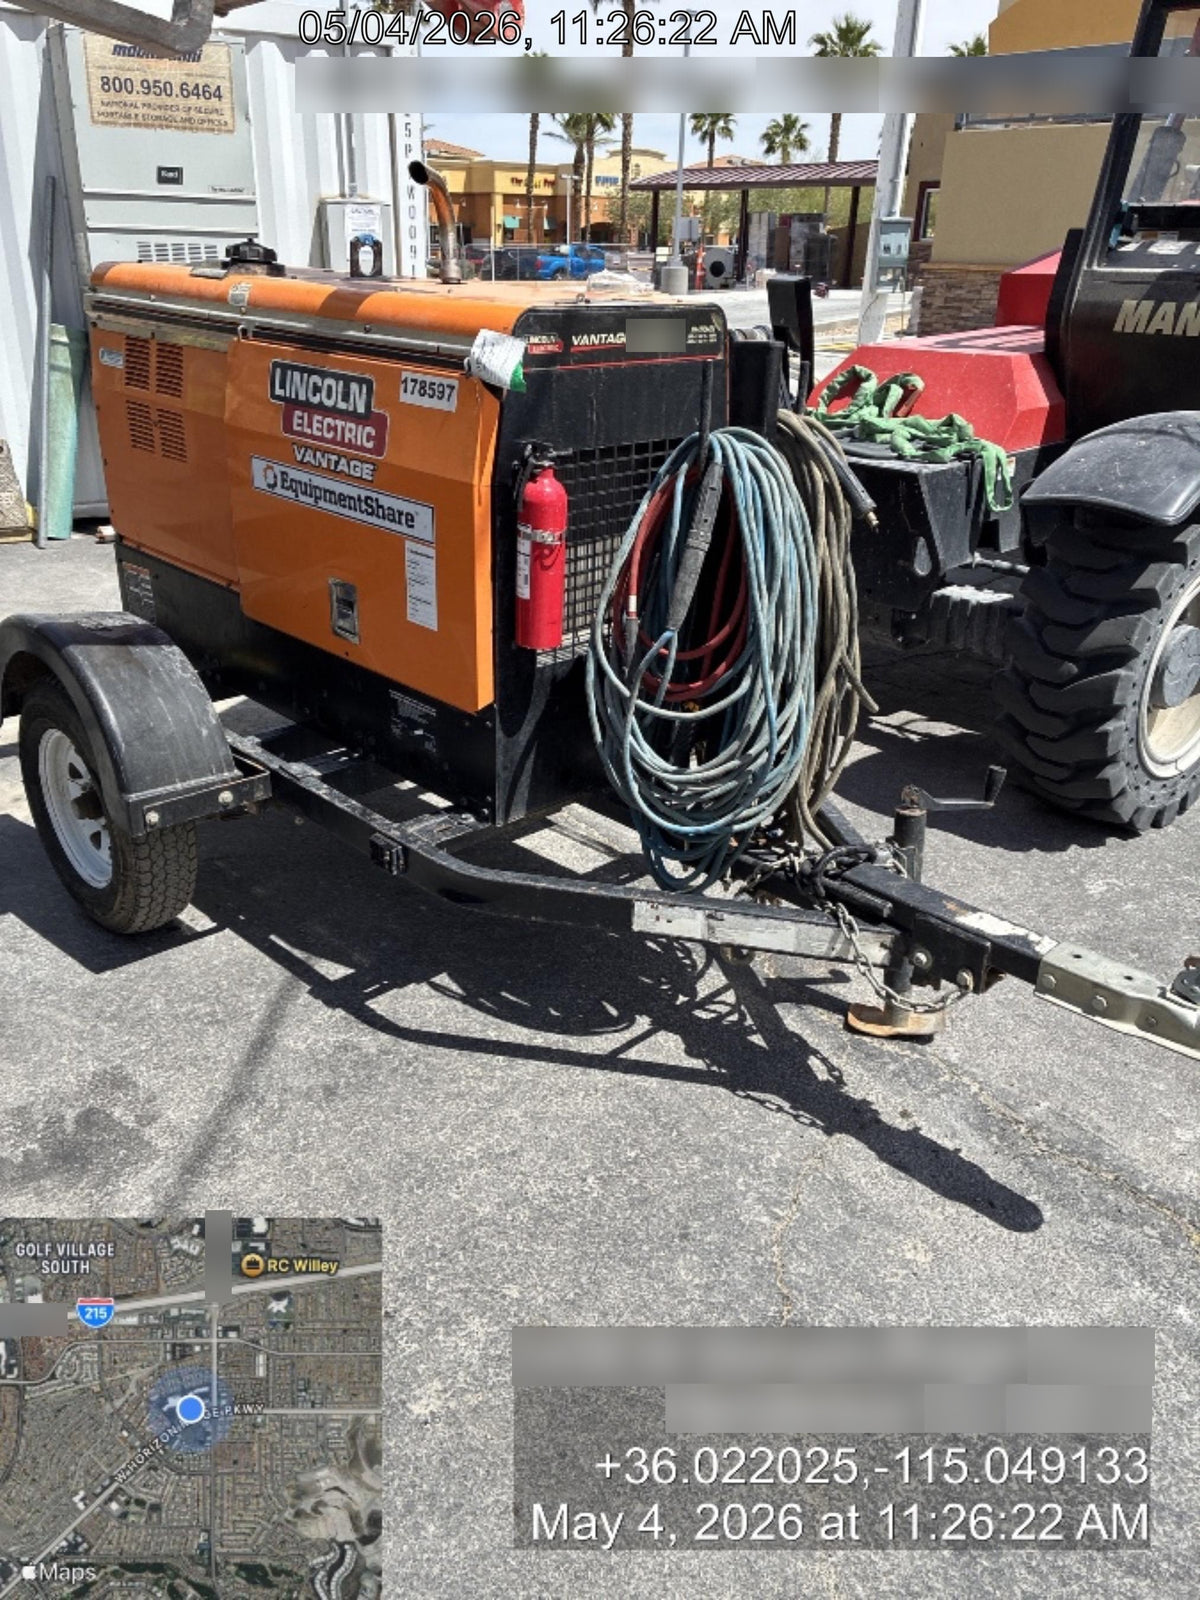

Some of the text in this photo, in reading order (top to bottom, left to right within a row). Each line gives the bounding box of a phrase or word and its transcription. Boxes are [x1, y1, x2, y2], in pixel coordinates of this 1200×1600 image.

[100, 76, 223, 101] 800.950.6464
[572, 332, 626, 345] VANTAG
[274, 367, 367, 414] LINCOLN
[402, 376, 456, 402] 178597
[292, 410, 376, 449] ELECTRIC
[292, 444, 376, 481] VANTAGE
[280, 470, 415, 529] EquipmentShare
